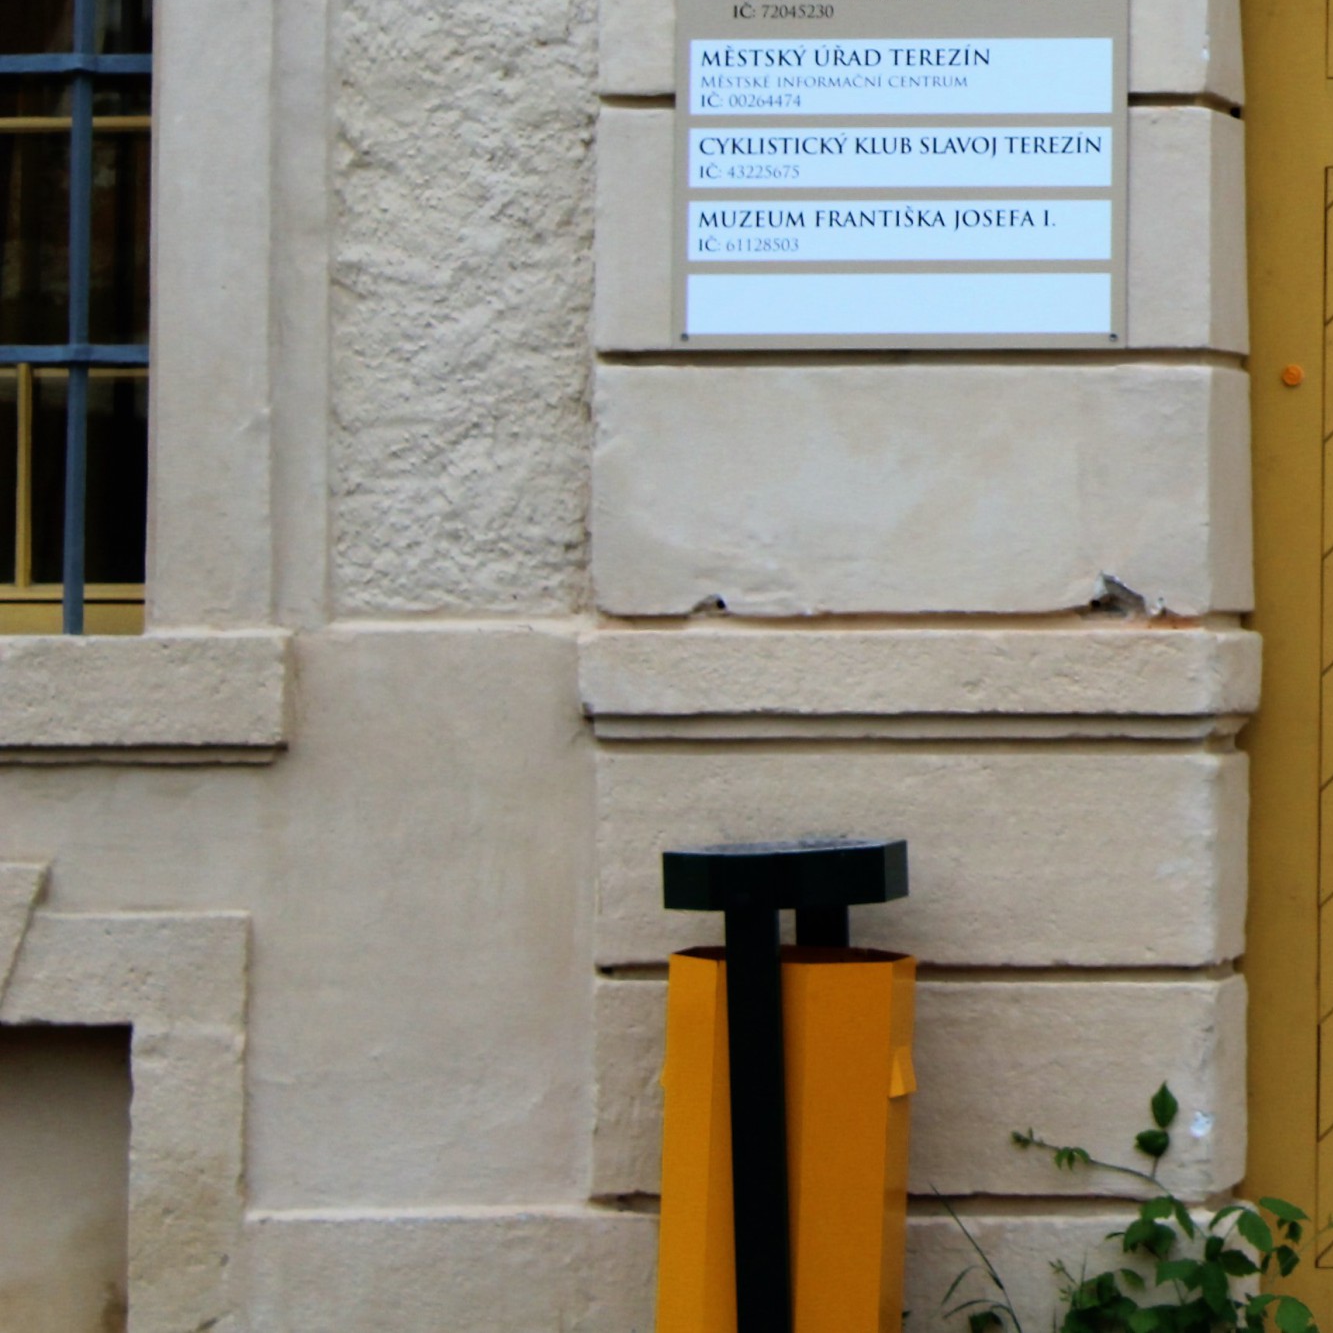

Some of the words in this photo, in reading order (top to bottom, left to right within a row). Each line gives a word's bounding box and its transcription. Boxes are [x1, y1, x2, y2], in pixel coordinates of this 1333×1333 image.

[732, 1, 755, 20] IČ:
[761, 3, 835, 20] 72045230
[701, 45, 806, 68] MĚSTSKÝ
[814, 45, 882, 67] ÚŘAD
[889, 44, 990, 67] TEREZÍN
[700, 74, 769, 89] MĚSTSKÉ
[776, 73, 882, 89] INFORMAČNÍ
[887, 75, 968, 89] CENTRUM
[700, 92, 722, 108] IČ:
[727, 93, 802, 109] 00264474
[698, 133, 848, 156] CYKLISTICKÝ
[854, 136, 913, 155] KLUB
[919, 136, 997, 157] SLAVOJ
[1004, 132, 1102, 155] TEREZÍN
[699, 162, 721, 179] IČ:
[726, 164, 800, 180] 43225675
[698, 210, 806, 229] MUZEUM
[815, 205, 946, 228] FRANTIŠKA
[954, 209, 1035, 231] JOSEFA
[1043, 209, 1055, 227] I.
[698, 235, 721, 253] IČ:
[725, 237, 800, 253] 61128503
